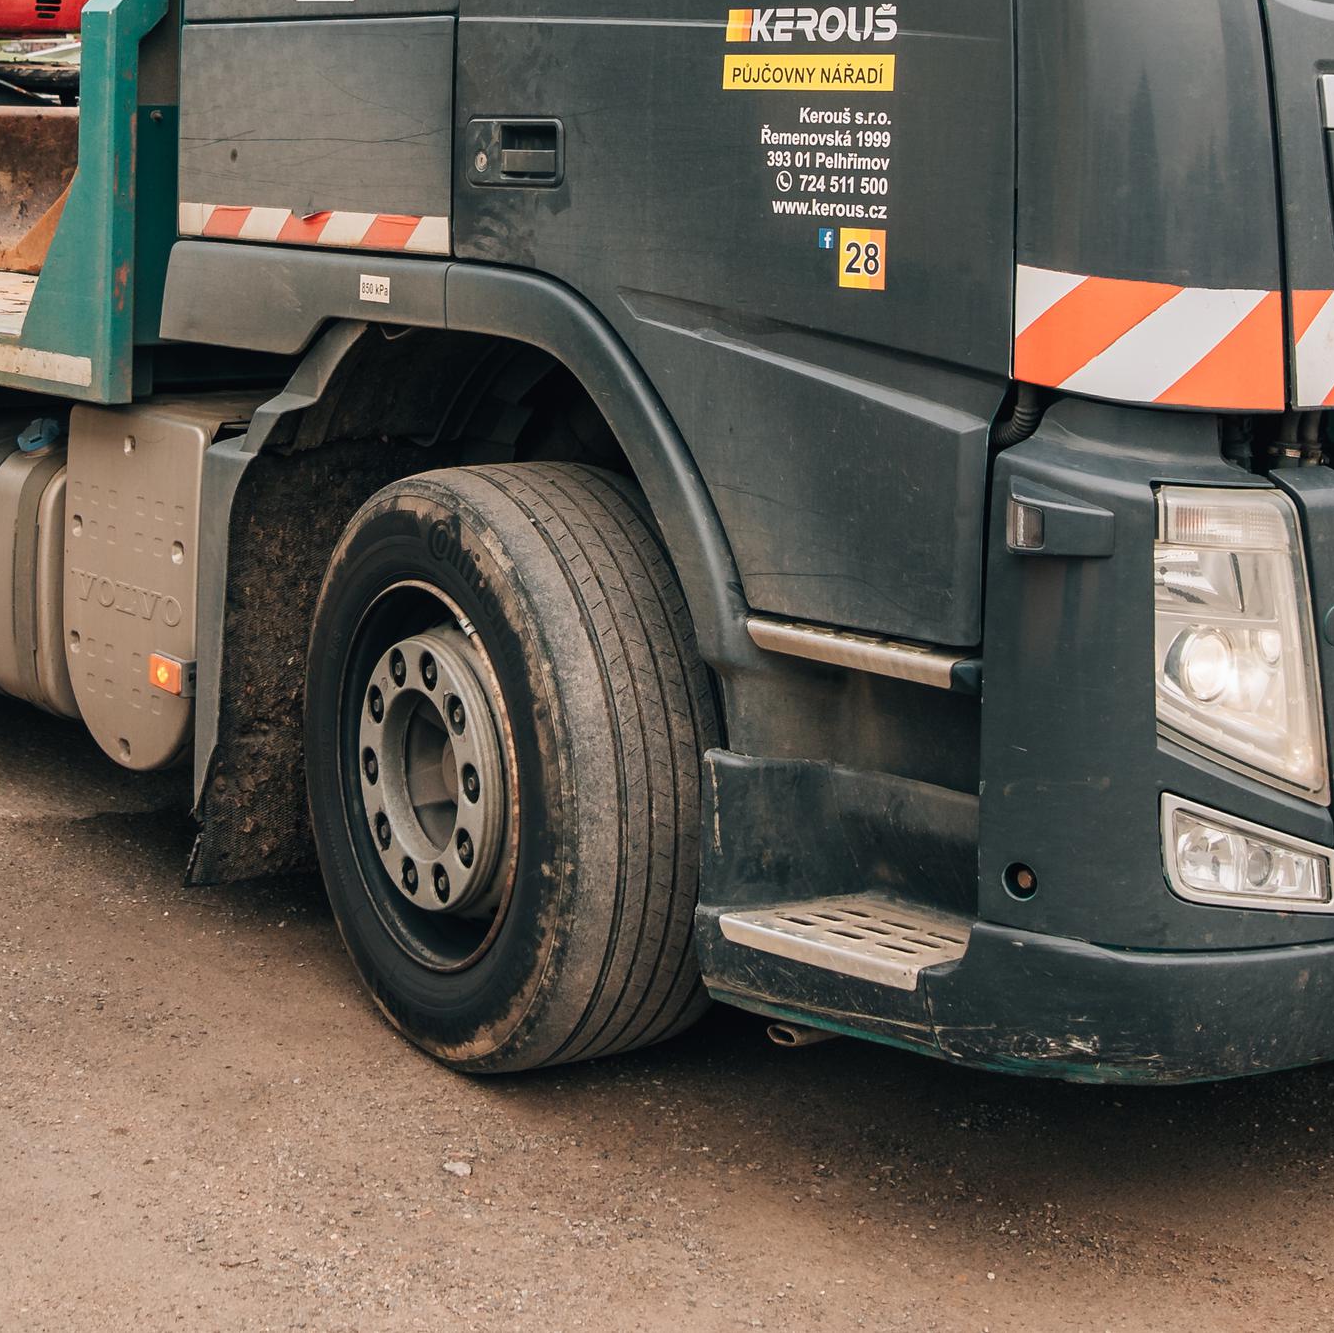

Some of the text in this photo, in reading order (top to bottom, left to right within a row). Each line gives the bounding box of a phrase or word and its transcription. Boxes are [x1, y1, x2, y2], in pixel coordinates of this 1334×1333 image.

[750, 3, 898, 42] KEROUŠ
[732, 63, 883, 84] PŮJČOVNY NÁŘADÍ
[799, 107, 892, 126] Kerouš s.r.o.
[760, 125, 891, 148] Řemenovská 1999
[767, 150, 890, 171] 393 01 Pelhřimov
[799, 174, 888, 196] 724 511 500
[772, 198, 888, 219] www.kerous.cz
[844, 241, 880, 277] 28
[375, 283, 389, 297] kPa
[70, 567, 182, 628] VOLVO
